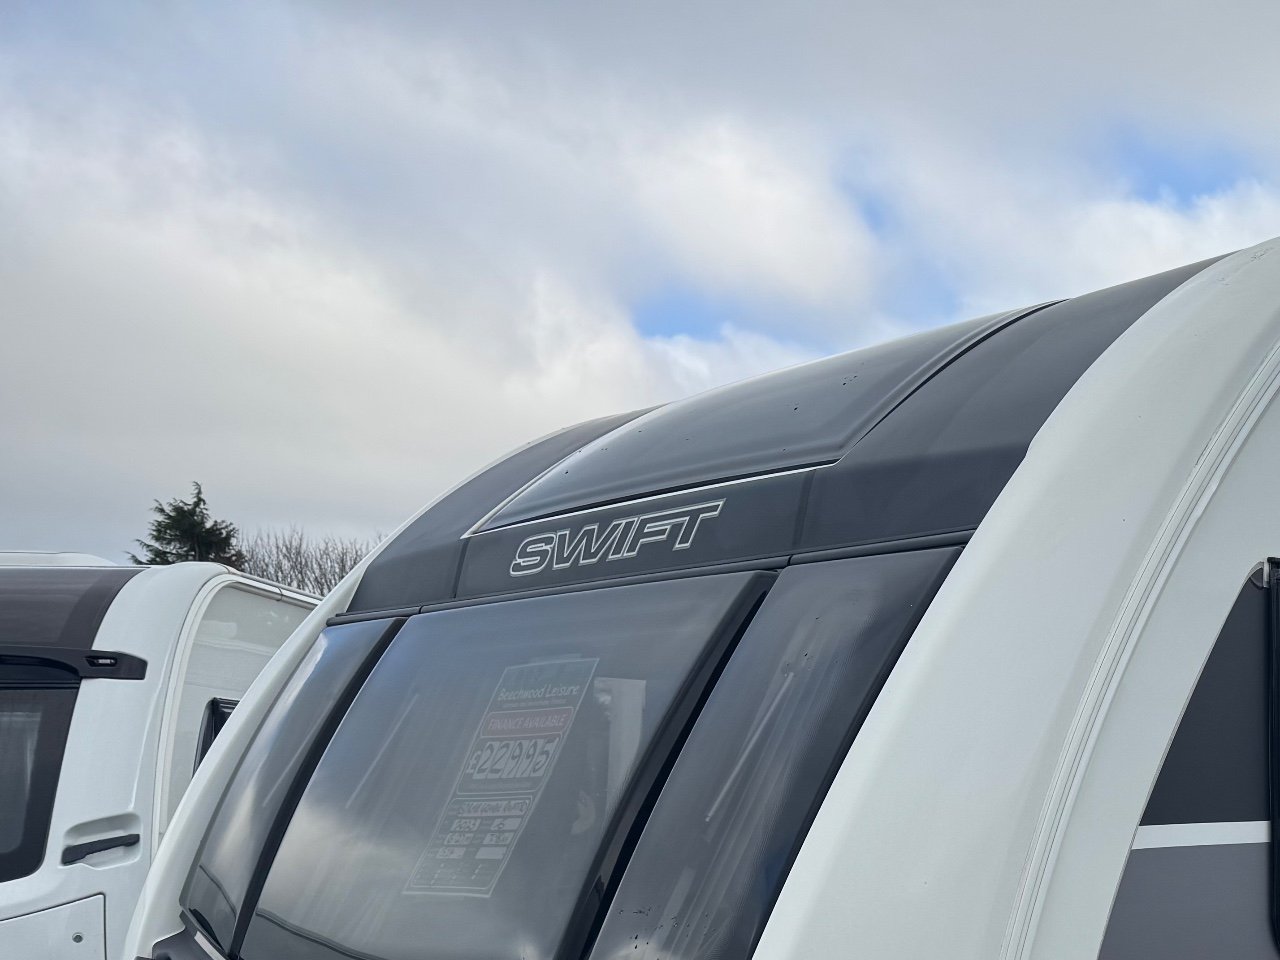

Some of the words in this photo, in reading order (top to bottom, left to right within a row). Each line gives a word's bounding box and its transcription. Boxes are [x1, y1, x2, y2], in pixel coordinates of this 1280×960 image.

[510, 498, 725, 577] SWIFT
[545, 683, 581, 698] Leisure
[488, 716, 524, 731] FINANCE
[524, 713, 568, 729] AVAILABLE
